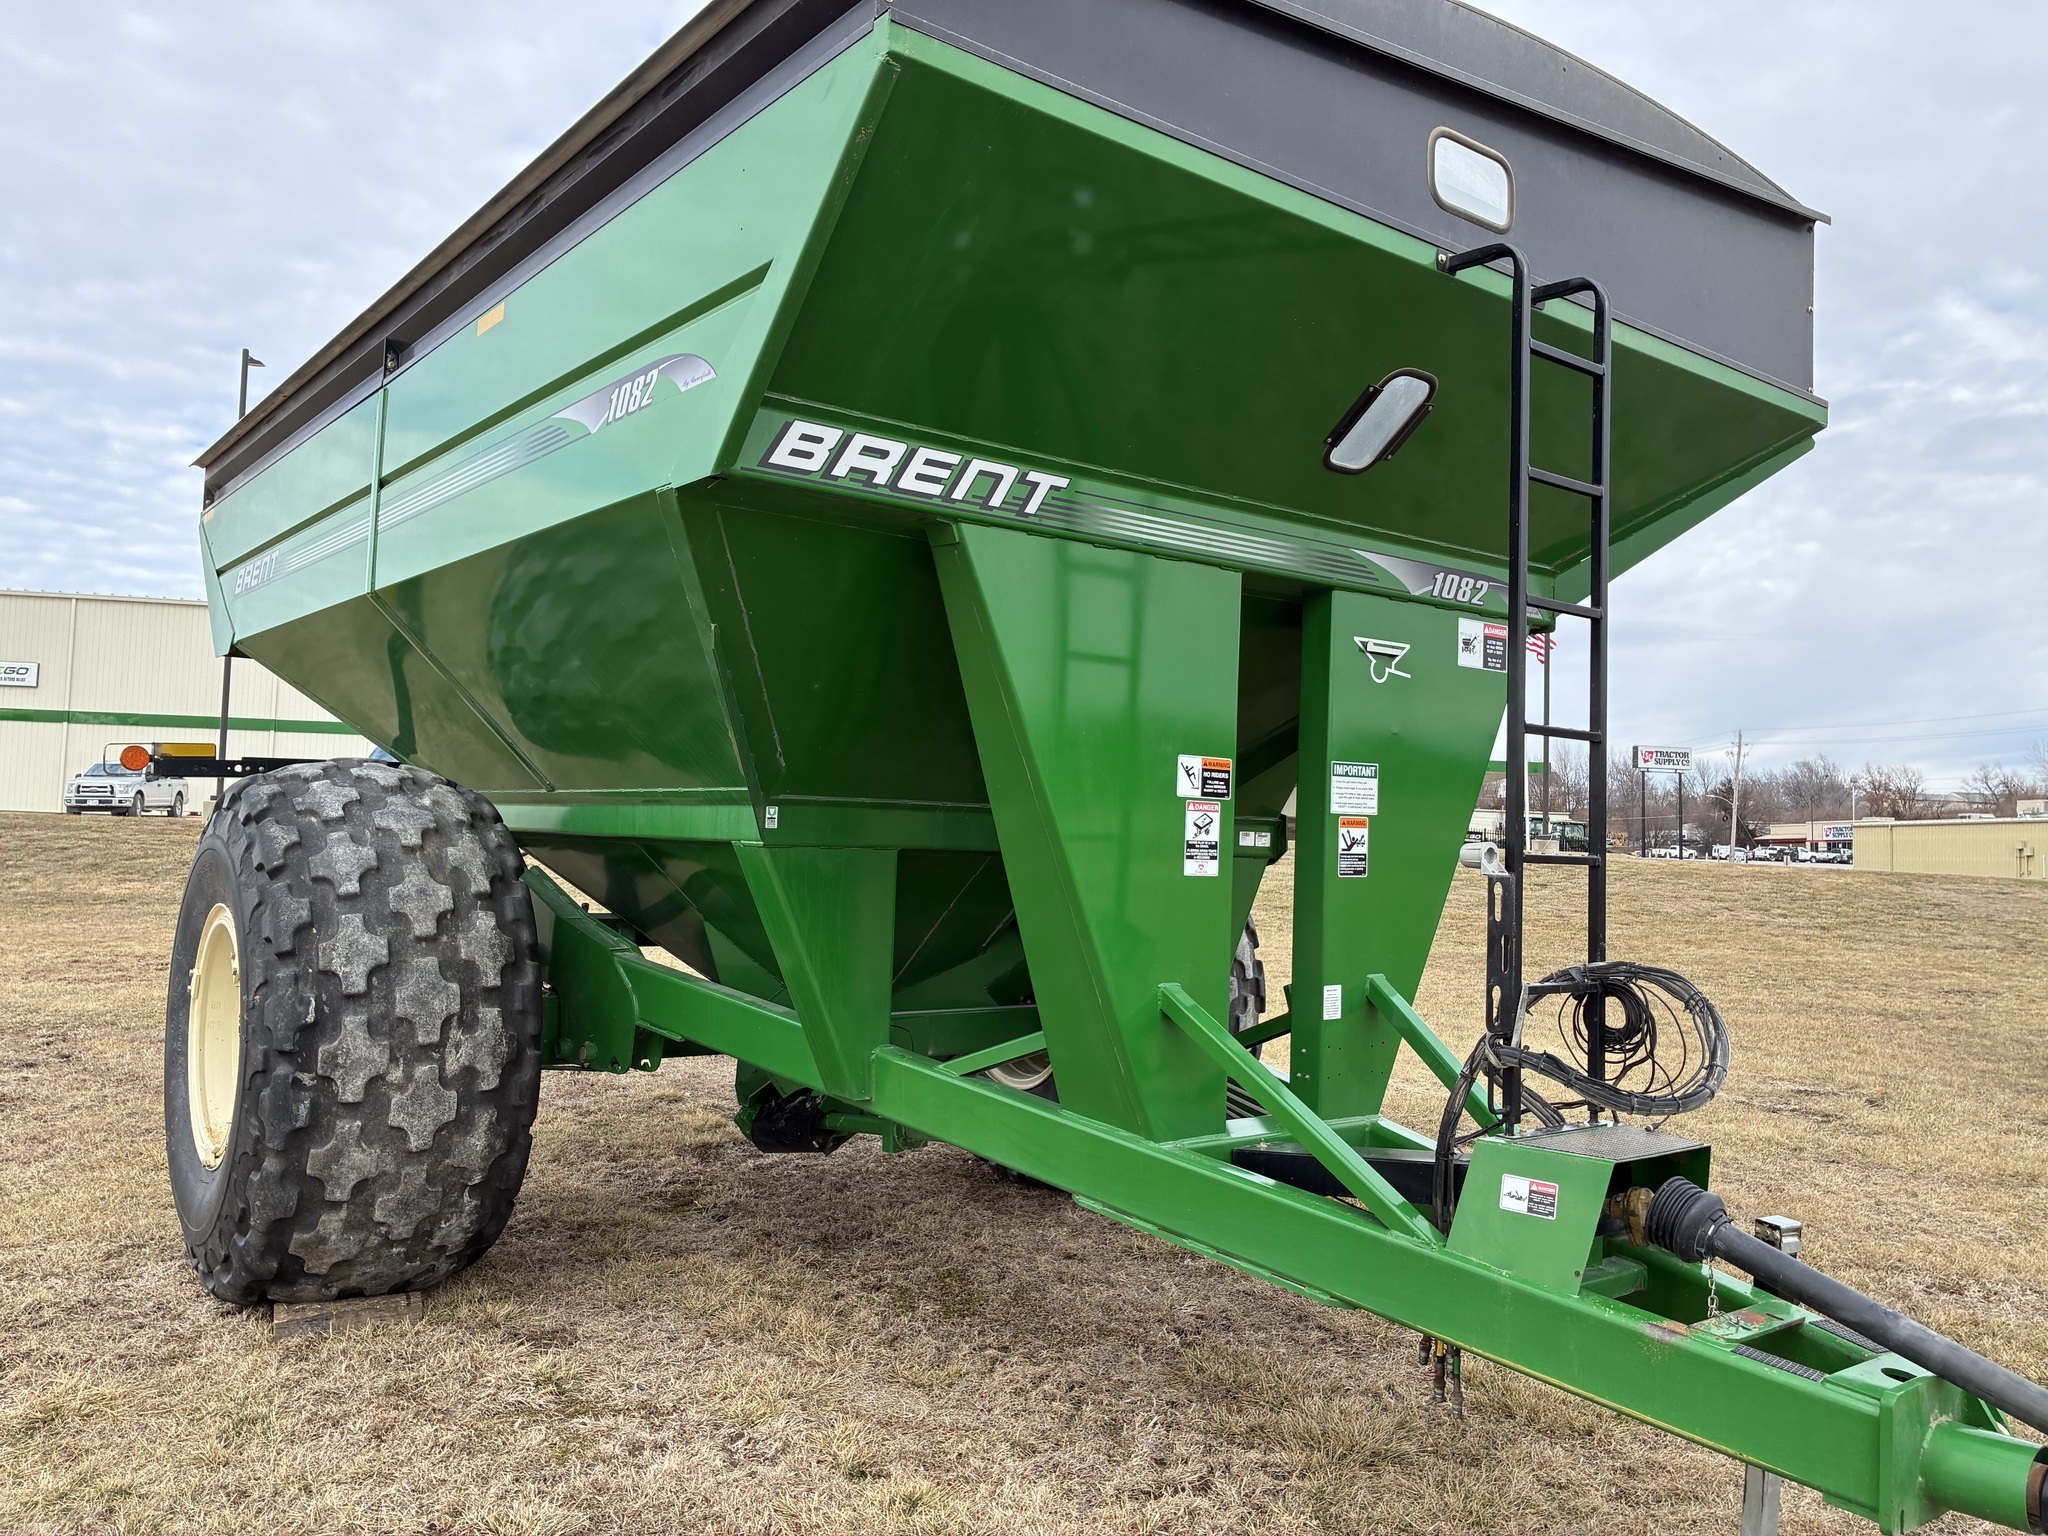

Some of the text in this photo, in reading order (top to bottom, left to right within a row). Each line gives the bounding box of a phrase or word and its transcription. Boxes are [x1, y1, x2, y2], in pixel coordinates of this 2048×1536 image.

[607, 367, 660, 424] 1082
[760, 419, 1071, 516] BRENT
[235, 549, 280, 595] BRENT
[1431, 571, 1490, 606] 1082
[1654, 750, 1690, 759] TRACTOR
[1207, 761, 1230, 769] WARNING
[1654, 757, 1681, 766] SUPPLY
[1333, 764, 1376, 777] IMPORTANT
[1194, 803, 1219, 811] DANGER
